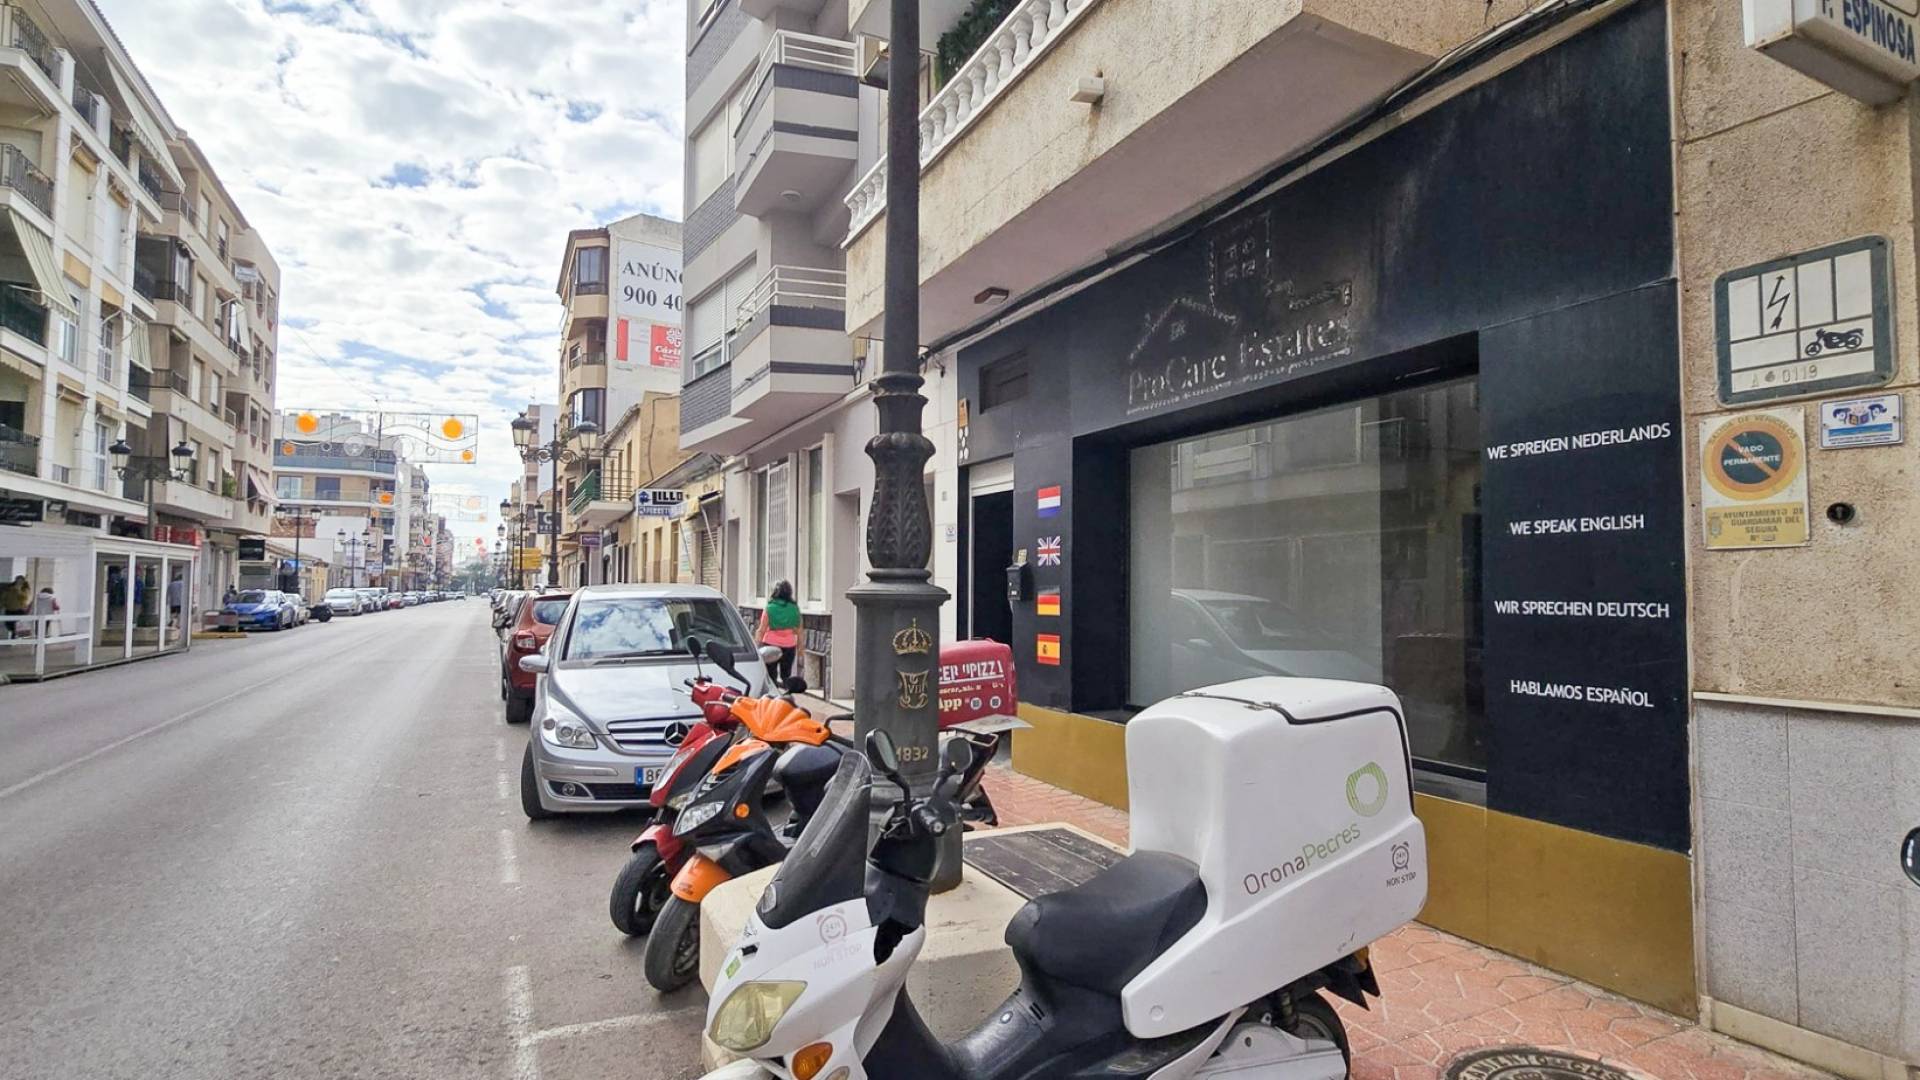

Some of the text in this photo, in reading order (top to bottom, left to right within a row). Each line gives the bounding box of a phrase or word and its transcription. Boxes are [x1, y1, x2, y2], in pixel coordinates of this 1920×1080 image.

[1843, 0, 1916, 65] ESPINOSA
[623, 285, 683, 312] 900 40
[1782, 365, 1818, 383] 0119
[1487, 422, 1671, 461] WE SPREKEN NEDERLANDS
[1738, 445, 1764, 453] VADO
[1723, 454, 1780, 466] PERMANENTE
[1510, 514, 1644, 535] WE SPEAK ENGLISH
[1494, 600, 1670, 618] WIR SPRECHEN DEUTSCH
[1510, 679, 1654, 708] HABLAMOS ESPAÑOL
[896, 746, 928, 762] 1832
[1243, 823, 1361, 895] OronaPecres
